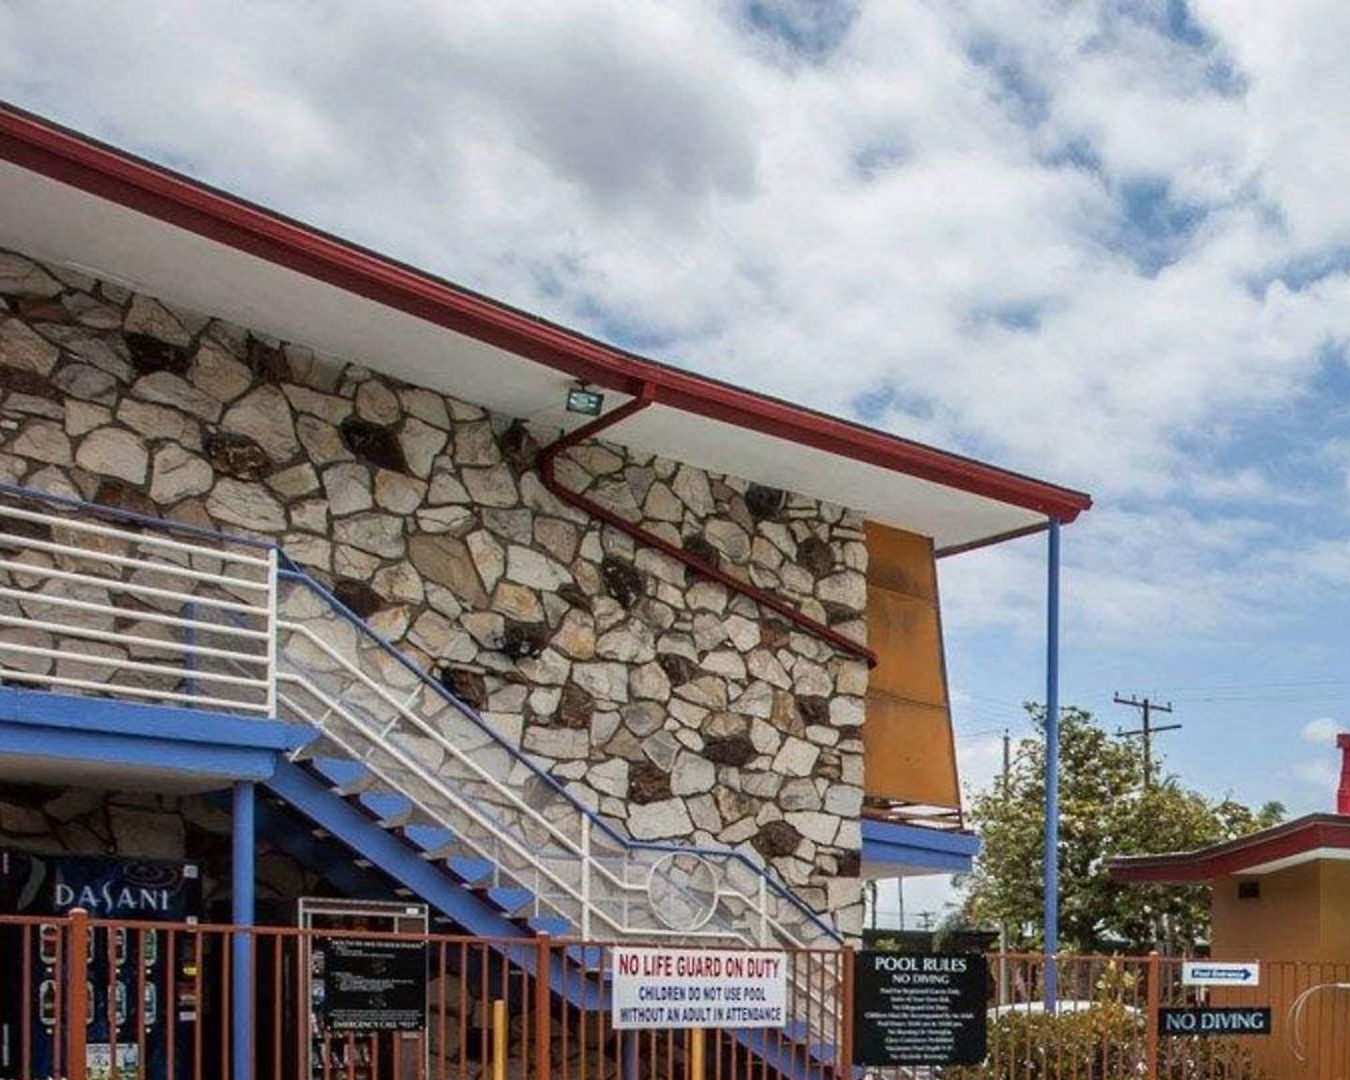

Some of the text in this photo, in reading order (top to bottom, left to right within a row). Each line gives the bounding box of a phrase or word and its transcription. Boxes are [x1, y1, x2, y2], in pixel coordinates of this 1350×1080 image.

[55, 881, 168, 912] DASANI
[619, 954, 780, 978] NO LIFE GUARD ON DUTY
[874, 957, 967, 972] POOL RULES
[892, 974, 950, 984] NO DIVING
[639, 986, 766, 1001] CHILDREN DO NOT USE POOL
[620, 1007, 781, 1021] WITHOUT AN ADULT IN ATTENDANCE
[1166, 1012, 1264, 1030] NO DIVING
